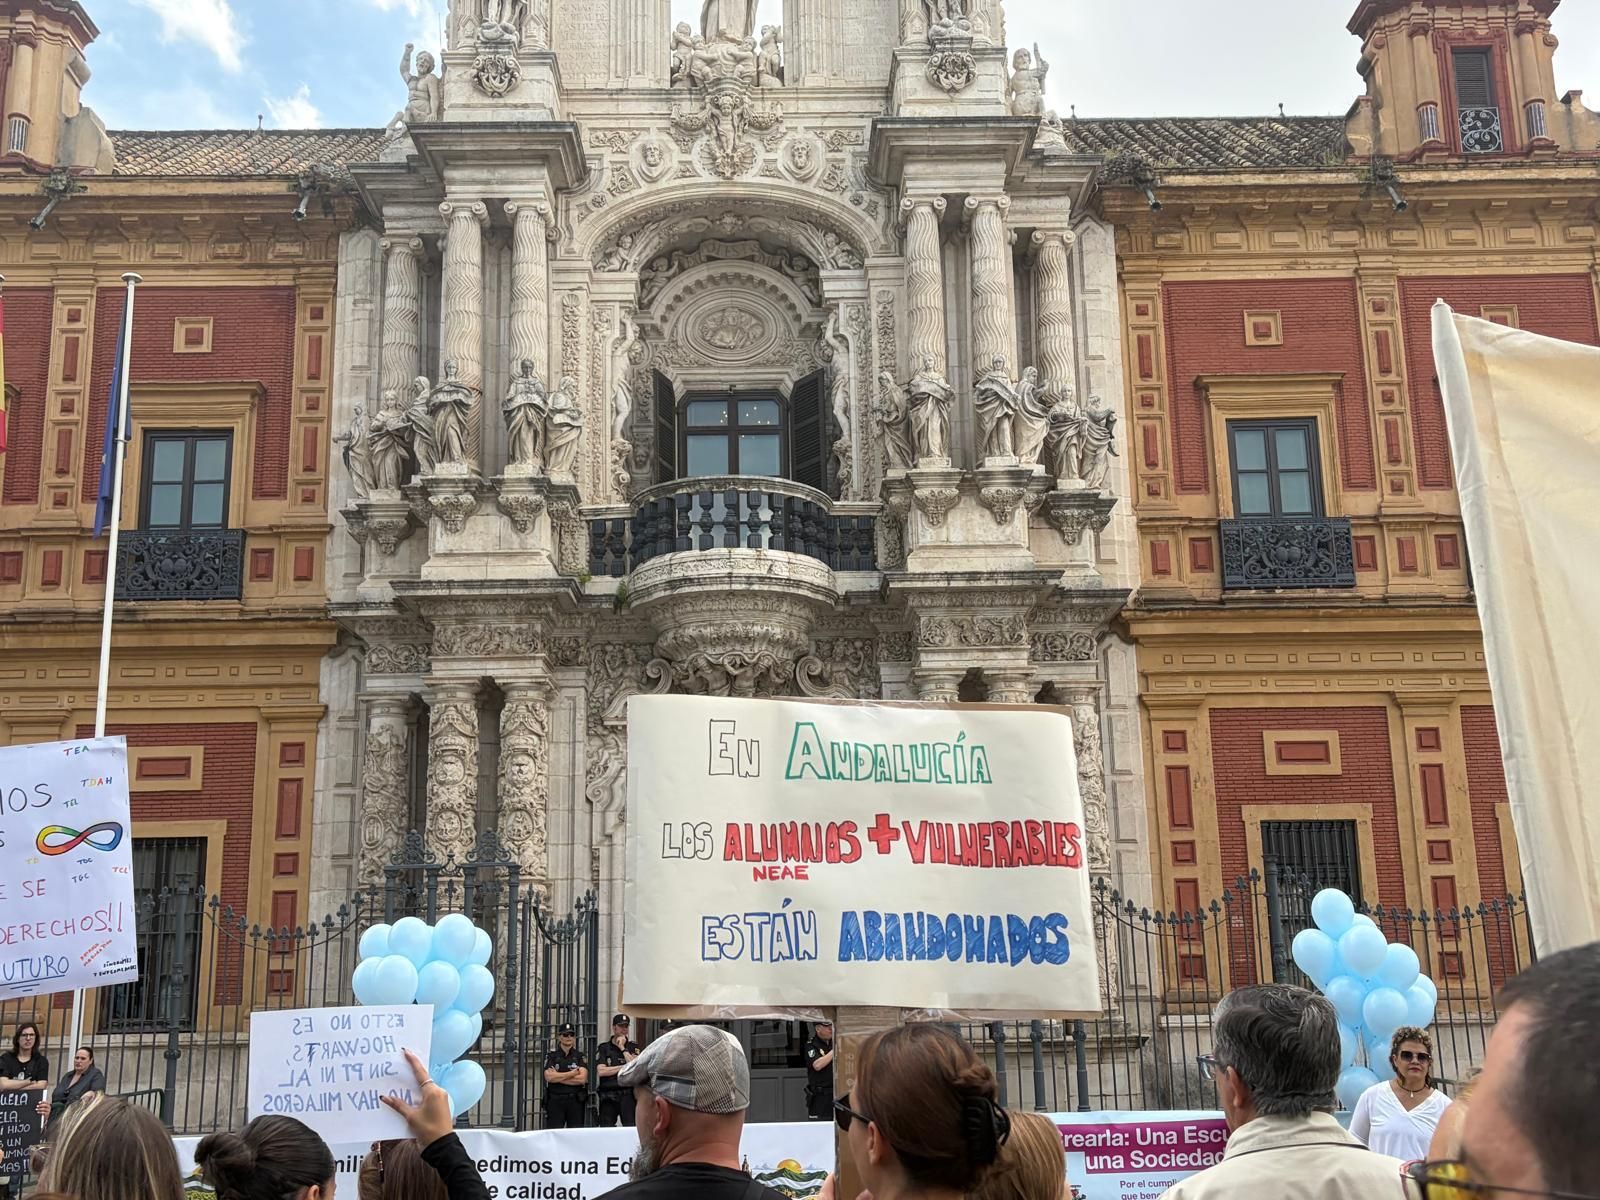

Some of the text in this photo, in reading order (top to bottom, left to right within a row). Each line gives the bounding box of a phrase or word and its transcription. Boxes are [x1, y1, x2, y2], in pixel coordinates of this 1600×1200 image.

[63, 745, 90, 756] TEA
[785, 721, 992, 784] ANDALUCÍA
[80, 776, 113, 788] TDAH
[0, 783, 53, 815] OS
[661, 821, 714, 861] LOS
[723, 820, 863, 863] ALUMNOS
[901, 819, 1084, 869] VULNERABLES
[753, 864, 809, 882] NEAE
[22, 878, 46, 898] SE
[701, 898, 1071, 967] ESTÁN ABANDONADOS
[6, 1136, 22, 1147] UN
[1058, 1129, 1130, 1147] rearla:
[1135, 1127, 1178, 1146] Una
[472, 1155, 553, 1174] edimos
[560, 1160, 599, 1175] una
[1085, 1154, 1125, 1170] una
[1120, 1180, 1135, 1189] Por
[1138, 1179, 1146, 1188] el
